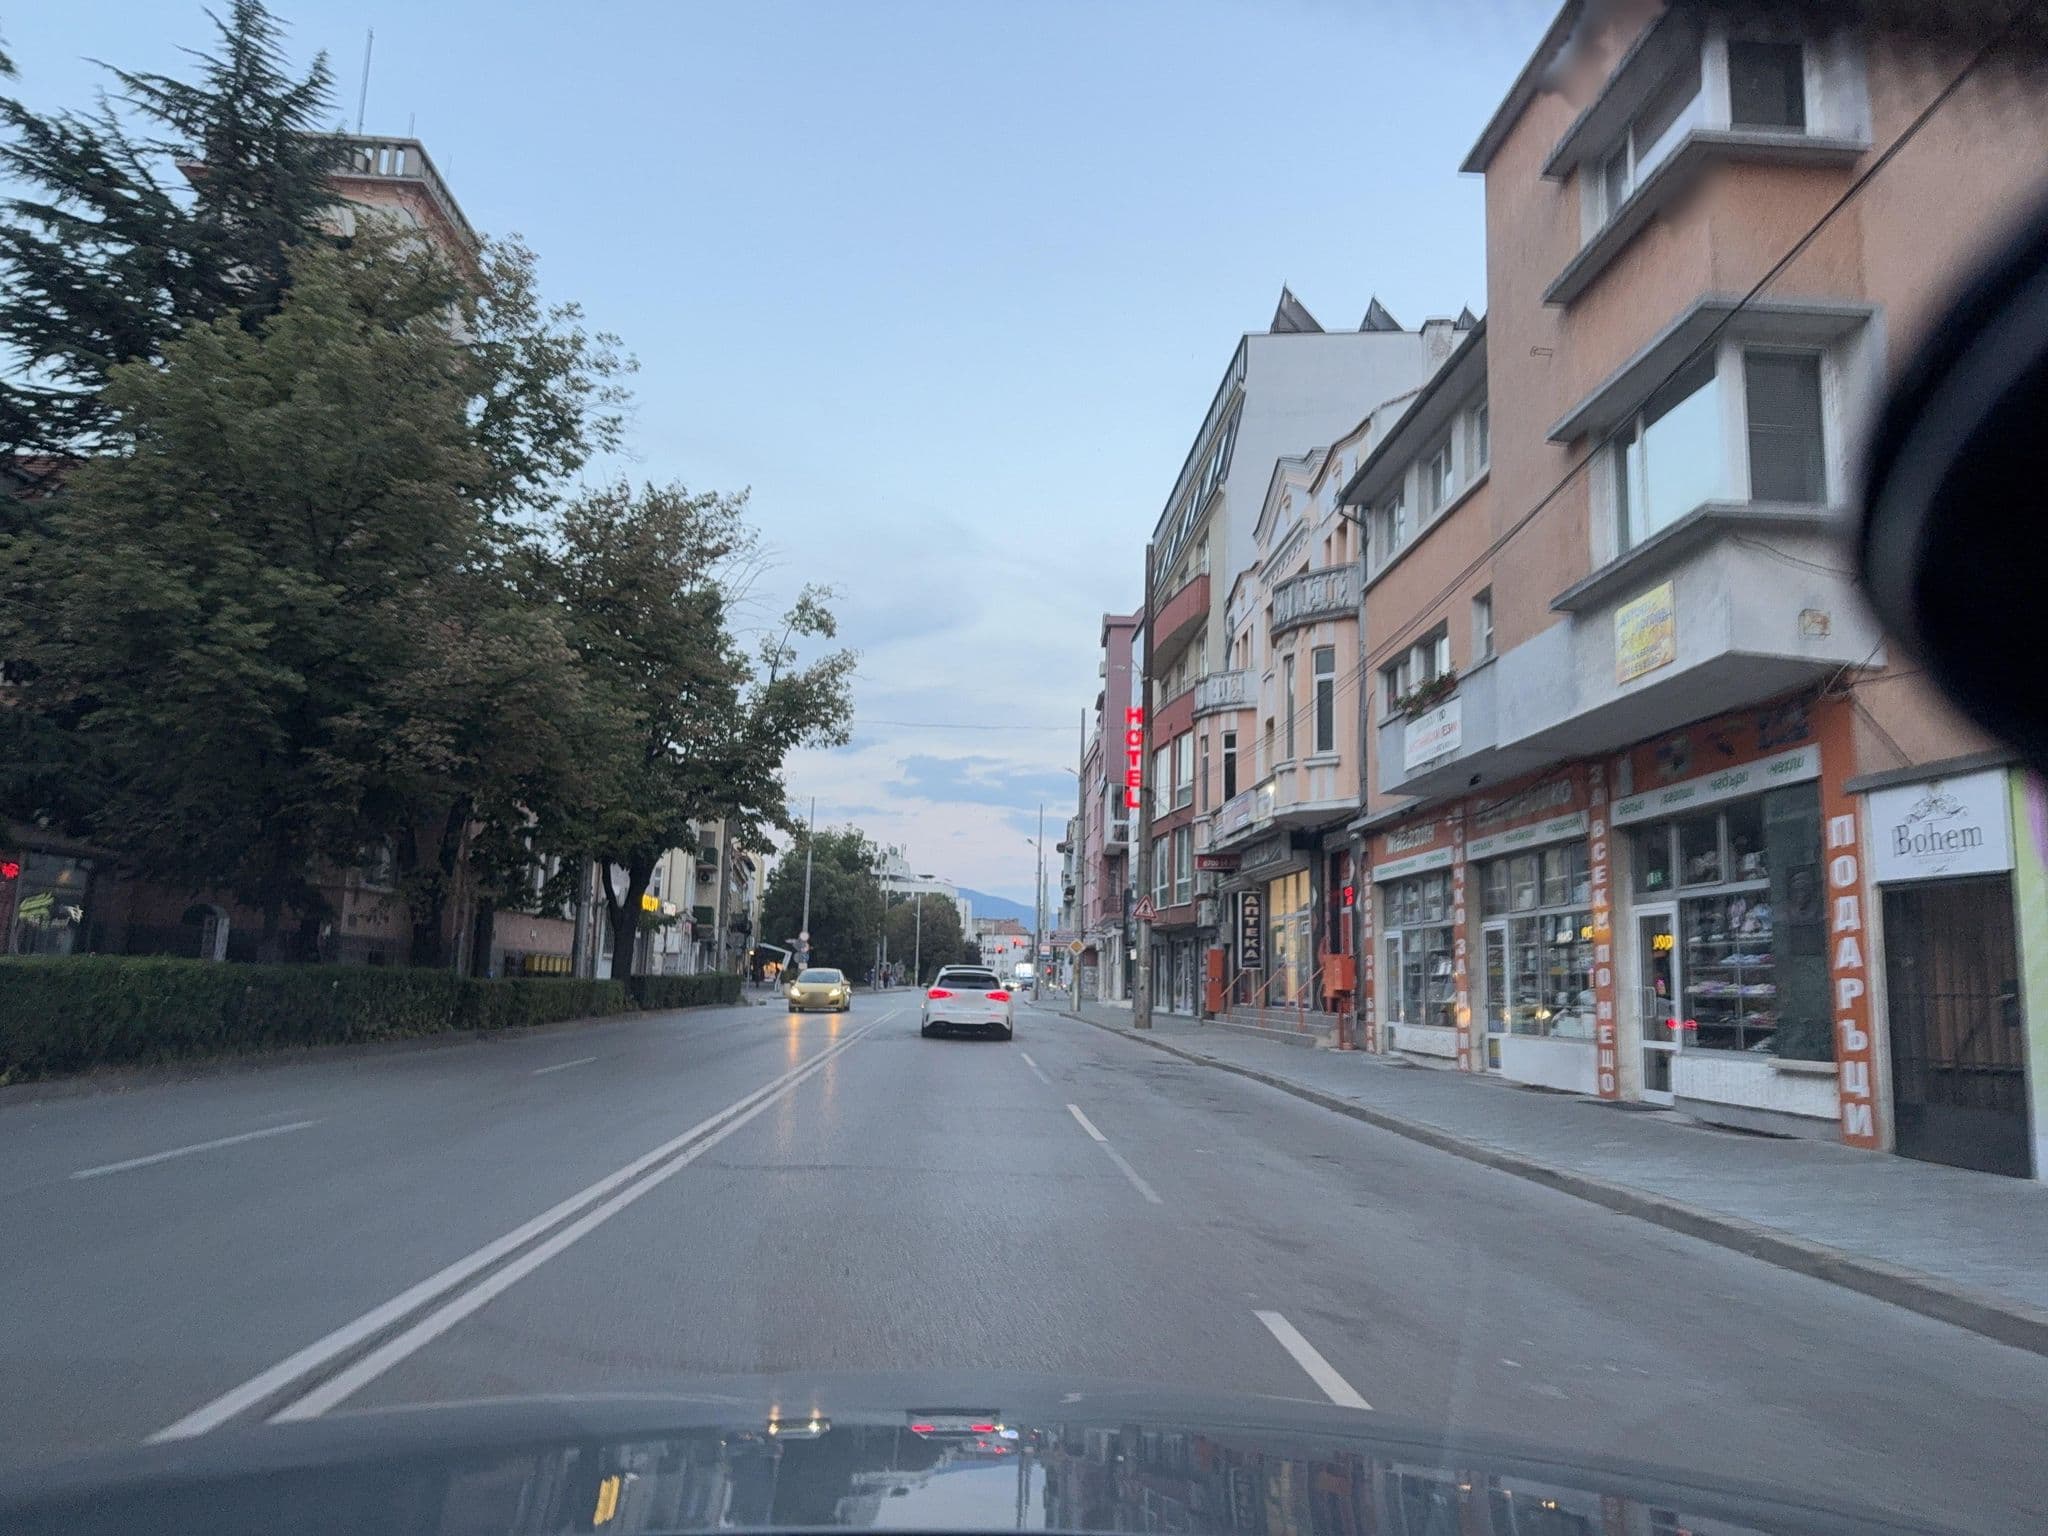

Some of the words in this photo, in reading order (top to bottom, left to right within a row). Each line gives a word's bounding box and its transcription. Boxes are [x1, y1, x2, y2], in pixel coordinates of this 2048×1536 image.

[1125, 706, 1145, 808] HOTEL
[1591, 819, 1609, 930] ВСЕКИ
[1892, 823, 1984, 857] Bohem
[1244, 895, 1259, 959] АПТЕКА
[1597, 944, 1611, 987] ПО
[1827, 814, 1874, 1138] ПОДАРЪЦИ
[1598, 1001, 1615, 1093] НЕЩО
